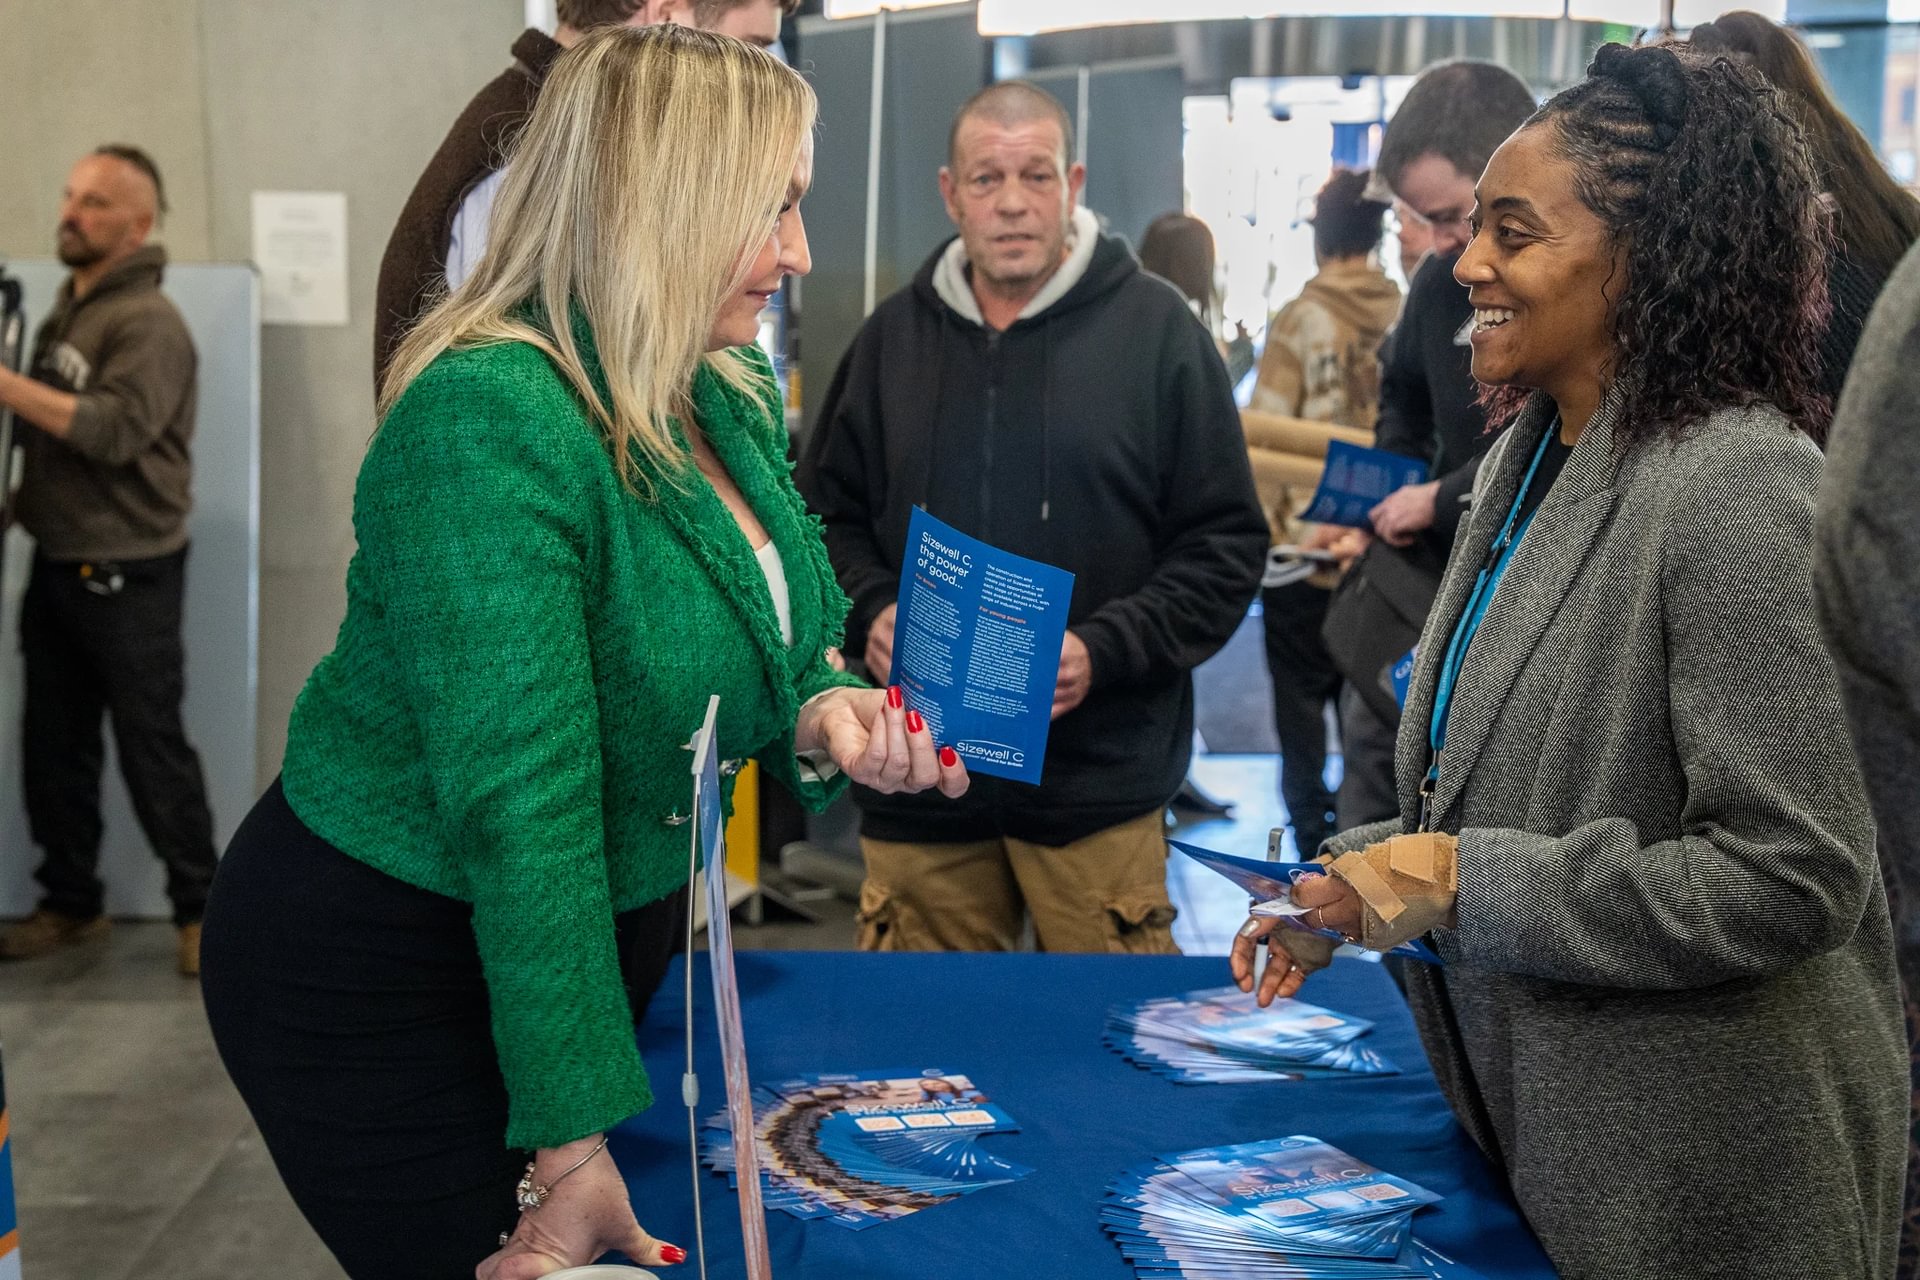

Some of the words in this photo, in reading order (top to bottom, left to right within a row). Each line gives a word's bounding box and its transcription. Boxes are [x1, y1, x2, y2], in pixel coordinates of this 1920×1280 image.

[922, 531, 960, 560] Sizewell
[917, 557, 929, 568] of
[920, 544, 935, 560] the
[936, 555, 969, 578] power
[956, 742, 1010, 760] Sizewell
[1013, 752, 1025, 763] C
[1231, 1175, 1338, 1196] Sizewell
[1340, 1169, 1366, 1179] C
